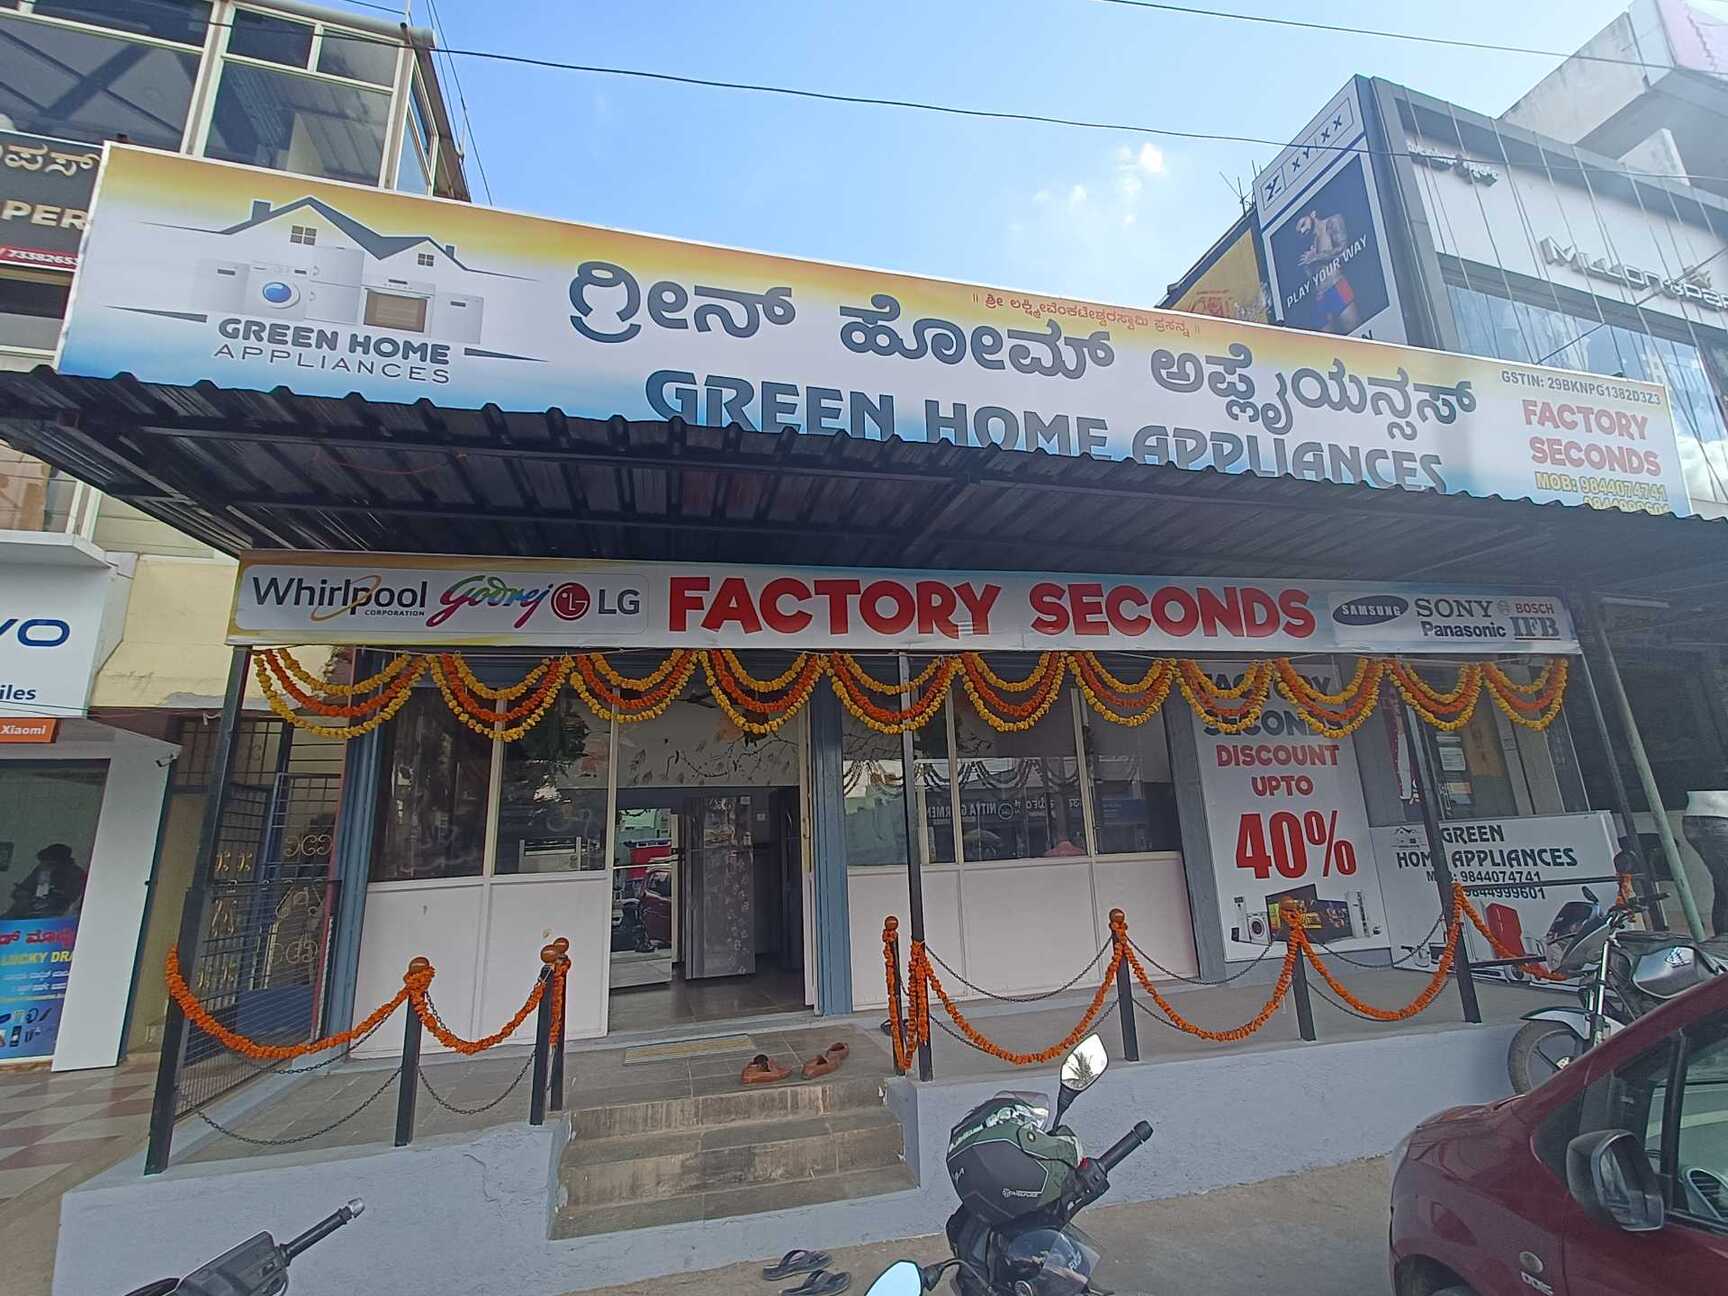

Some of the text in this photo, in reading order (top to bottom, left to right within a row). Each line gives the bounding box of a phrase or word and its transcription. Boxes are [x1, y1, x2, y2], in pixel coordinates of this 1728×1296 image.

[1287, 235, 1368, 308] PLAY YOUR WAY
[568, 260, 797, 344] ಗ್ರೀನ್
[838, 293, 1116, 381] ಹೋಮ್
[218, 318, 451, 366] GREEN HOME
[214, 343, 450, 384] APPLIANCES
[1501, 370, 1545, 388] GSTIN:
[1522, 399, 1649, 441] FACTORY
[645, 369, 1447, 495] GREEN HOME APPLIANCES
[1529, 436, 1662, 477] SECONDS
[1534, 471, 1578, 493] MOB:
[252, 576, 427, 616] Whirlpool
[426, 575, 553, 628] Godrej
[598, 589, 641, 616] LG
[365, 609, 426, 618] CORPORATION
[667, 575, 1318, 640] FACTORY SECONDS
[1341, 604, 1402, 617] SAMSUNG
[1415, 598, 1494, 619] SONY
[1515, 602, 1554, 615] BOSCH
[1420, 620, 1507, 638] Panasonic
[1509, 616, 1560, 638] IFB
[1, 724, 47, 736] Xiaomi
[1216, 744, 1340, 768] DISCOUNT
[1251, 775, 1314, 797] UPTO
[1235, 810, 1357, 880] 40%
[1440, 824, 1505, 845] GREEN
[1396, 851, 1437, 869] HOM
[1451, 848, 1578, 869] APPLIANCES
[1460, 870, 1542, 883] 9844074741
